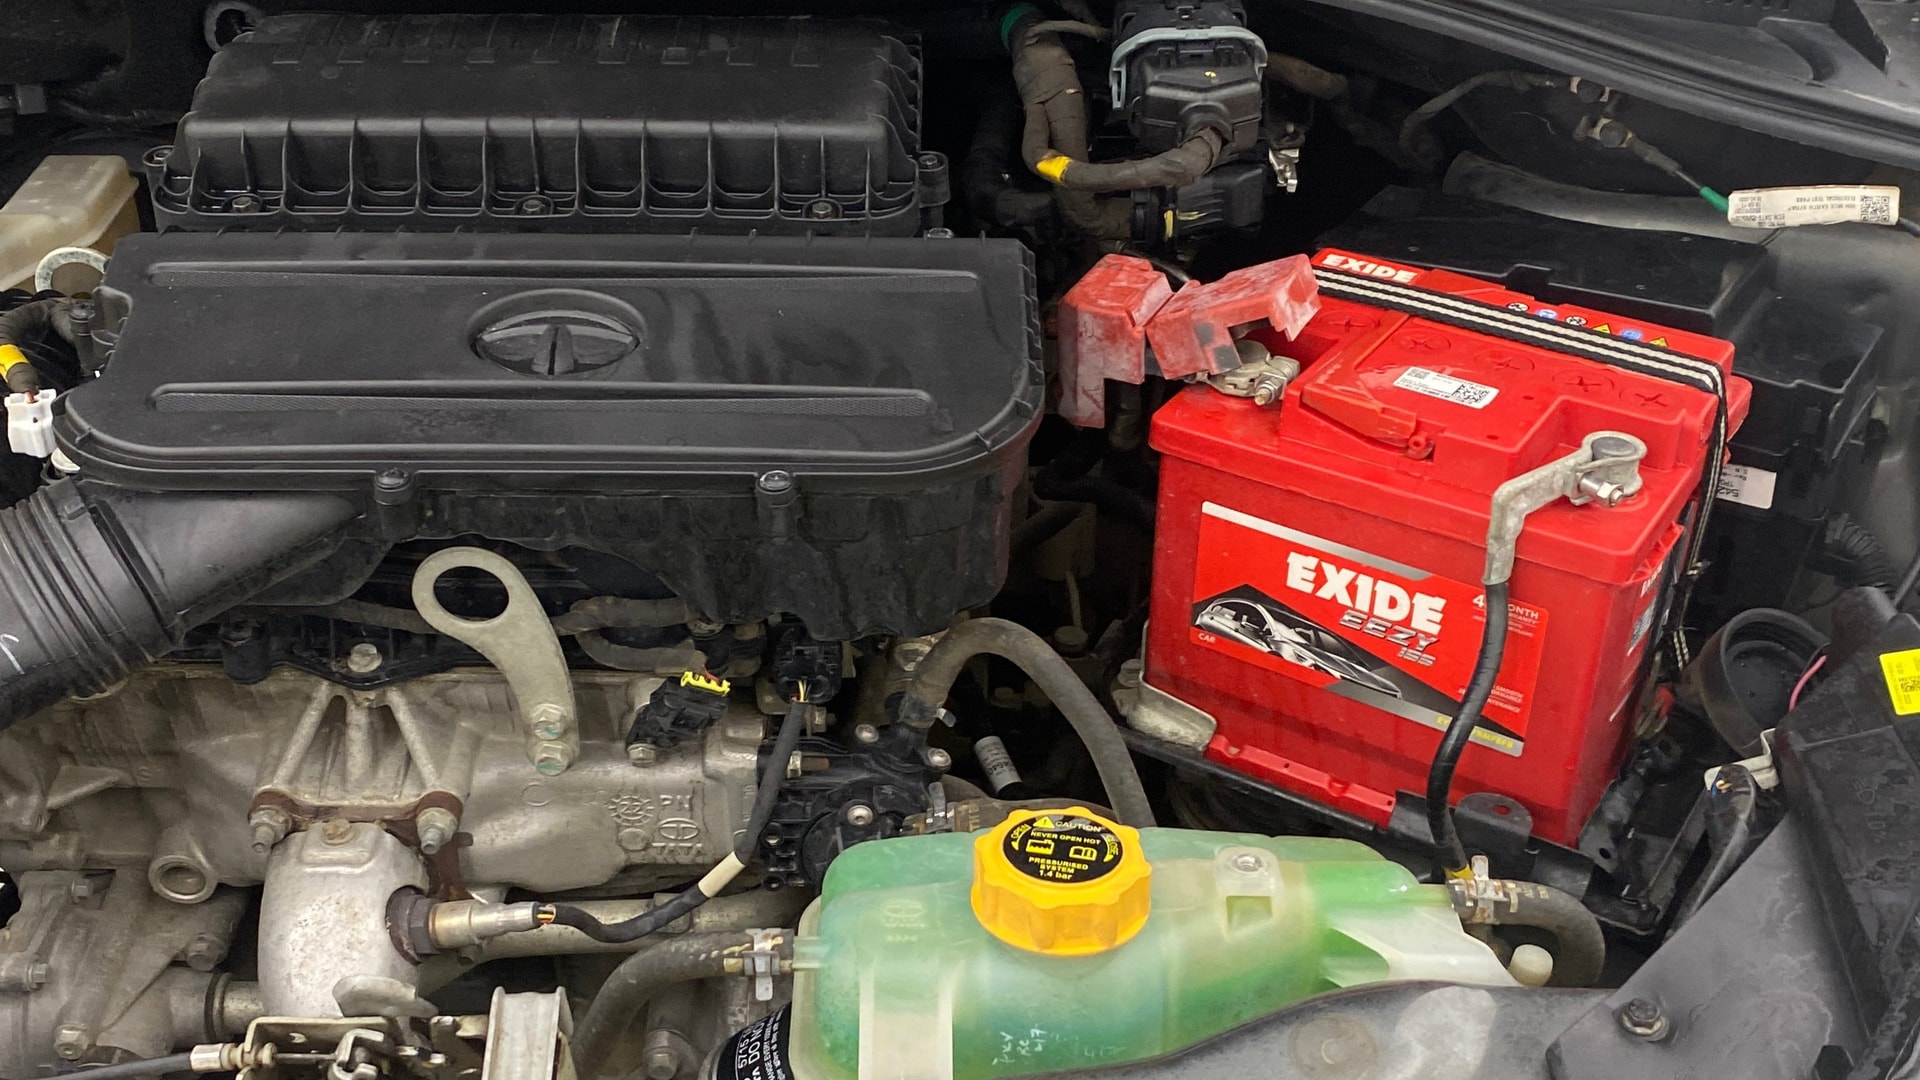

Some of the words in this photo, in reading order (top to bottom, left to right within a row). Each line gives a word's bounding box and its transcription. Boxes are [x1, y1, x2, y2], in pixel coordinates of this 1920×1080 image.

[1322, 253, 1418, 284] EXIDE
[1286, 551, 1447, 636] EXIDE
[1507, 603, 1539, 620] ONTH
[1198, 633, 1216, 644] CAR
[1339, 609, 1440, 652] EEZY
[1055, 821, 1102, 833] CAUTION
[1030, 831, 1058, 840] NEVER
[1059, 834, 1082, 843] OPEN
[651, 842, 704, 863] TATA
[1028, 856, 1089, 871] PRESSURISED
[1039, 864, 1075, 874] SYSTEM
[1038, 869, 1054, 878] 1.4
[1055, 871, 1073, 880] bar
[738, 1038, 750, 1069] 5715
[748, 1041, 761, 1065] DO
